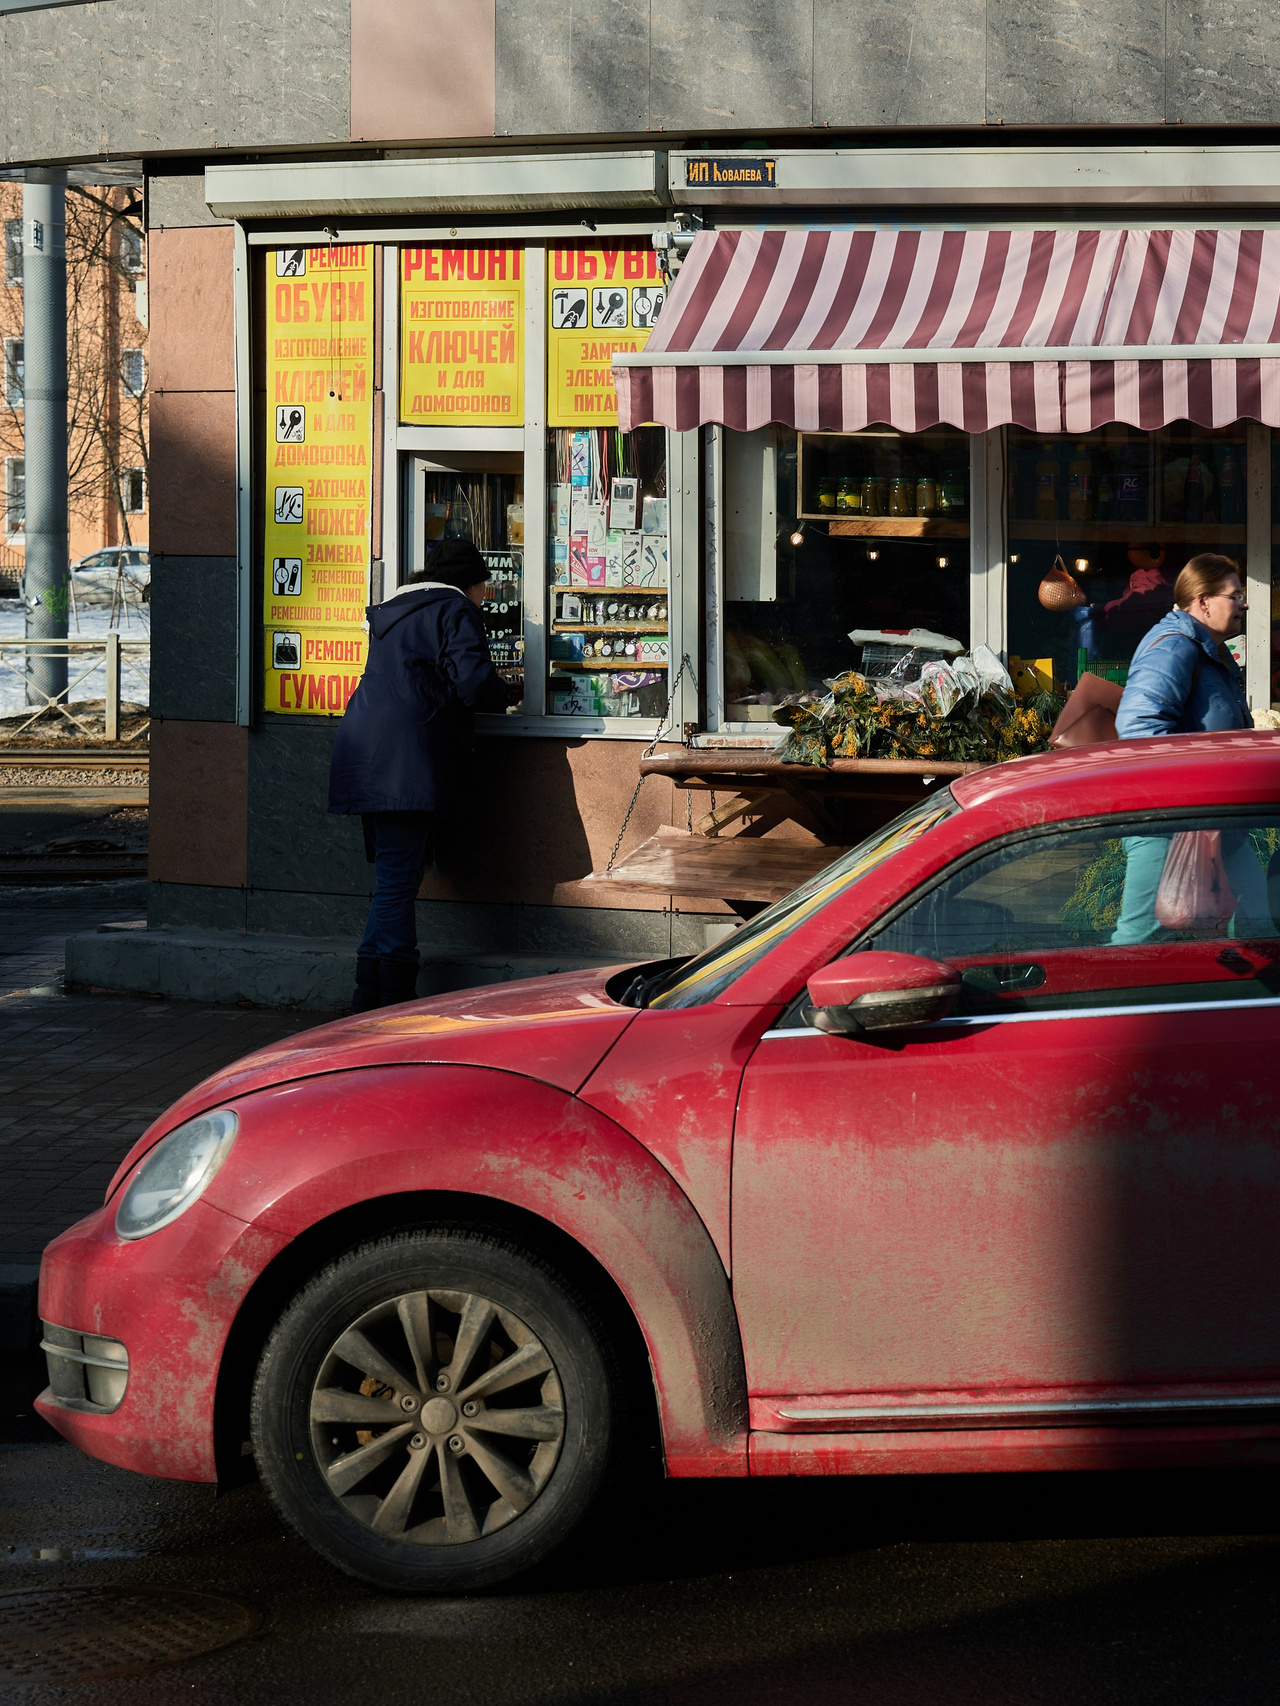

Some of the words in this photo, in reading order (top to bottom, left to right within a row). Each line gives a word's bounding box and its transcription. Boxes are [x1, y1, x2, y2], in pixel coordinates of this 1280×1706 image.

[689, 162, 709, 182] ИП
[765, 162, 775, 182] Т
[309, 243, 367, 268] РЕМОНТ
[404, 236, 525, 281] РЕМОНТ
[275, 281, 364, 323] ОБУВИ
[410, 300, 515, 318] ИЗГОТОВЛЕНИЕ
[274, 337, 366, 358] ИЗГОТОВЛЕНИЕ
[409, 323, 515, 364] КЛЮЧЕЙ
[580, 342, 638, 360] ЗАМЕНА
[275, 363, 366, 402] КЛЮЧЕЙ
[437, 370, 447, 388] И
[453, 370, 485, 389] ДЛЯ
[566, 369, 614, 387] ЭЛЕМЕ
[411, 395, 511, 413] ДОМОФОНОВ
[574, 394, 618, 412] ПИТА
[313, 414, 322, 431] И
[325, 414, 355, 432] ДЛЯ
[274, 445, 366, 467] ДОМОФОНА
[307, 479, 366, 498] ЗАТОЧКА
[1123, 477, 1138, 490] RC
[307, 503, 365, 536] НОЖЕЙ
[306, 544, 363, 563] ЗАМЕНА
[483, 557, 513, 568] ИМ
[311, 570, 364, 584] ЭЛЕМЕНТОВ
[490, 570, 518, 581] ТЫ:
[317, 587, 364, 603] ПИТАНИЯ,
[271, 606, 322, 621] РЕМЕШКОВ
[325, 607, 331, 621] В
[333, 607, 364, 622] ЧАСАХ
[305, 639, 362, 662] РЕМОНТ
